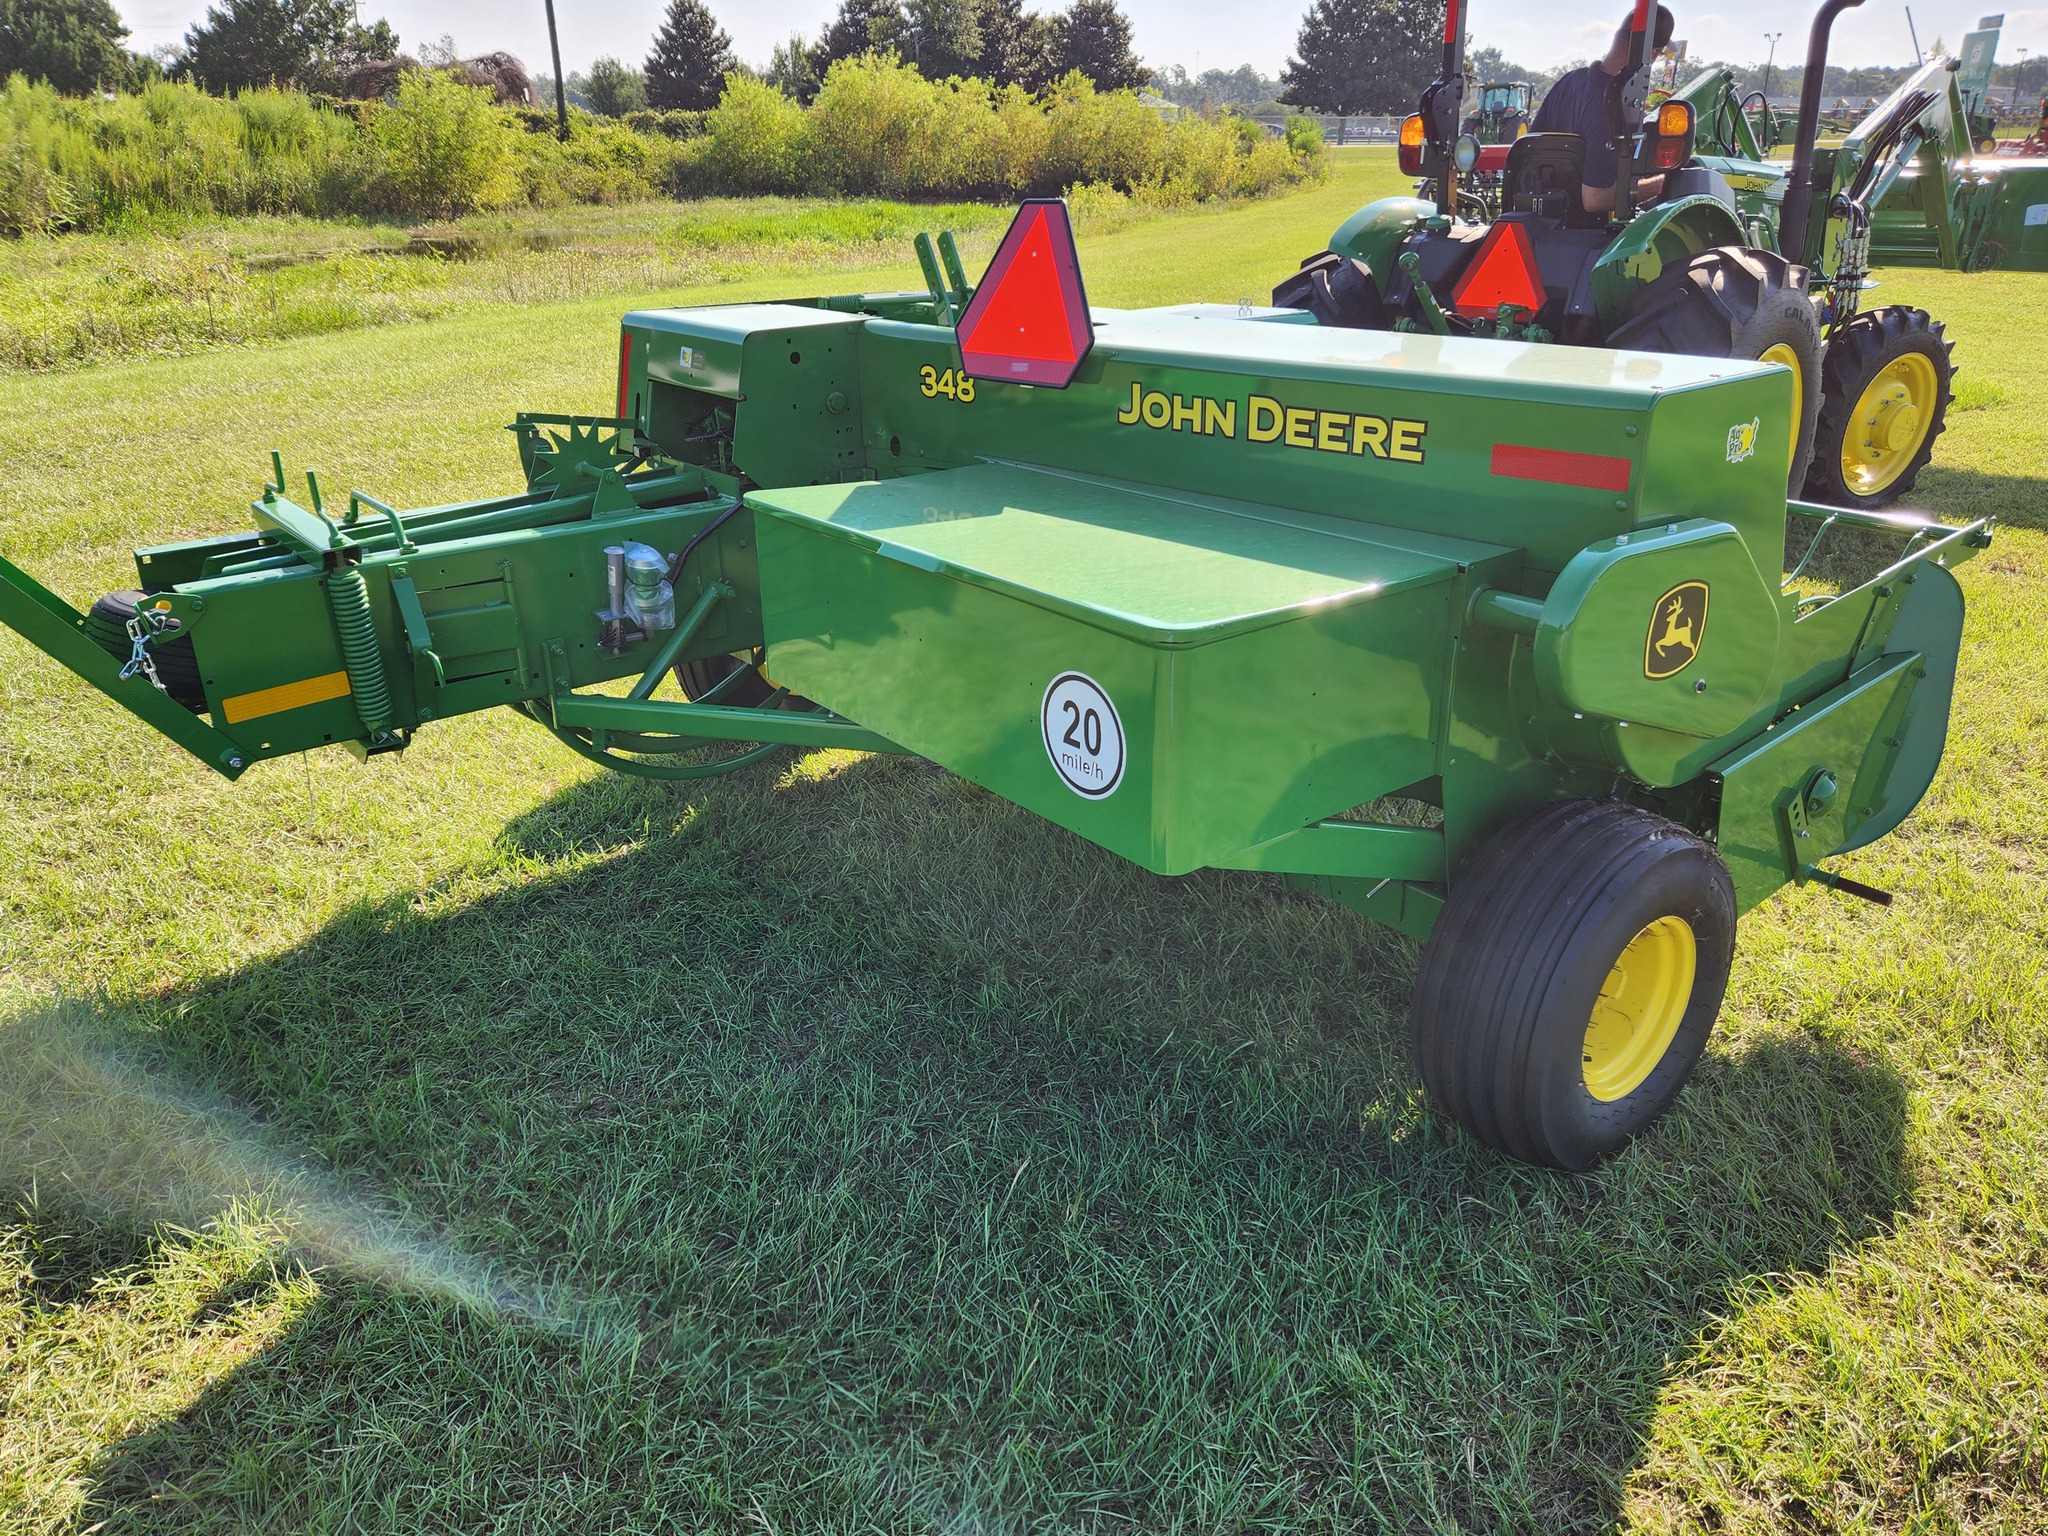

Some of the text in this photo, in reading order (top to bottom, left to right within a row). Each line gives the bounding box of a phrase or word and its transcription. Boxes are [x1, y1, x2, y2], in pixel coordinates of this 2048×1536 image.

[1744, 179, 1763, 192] JOHN
[919, 364, 977, 403] 348
[1117, 381, 1429, 465] JOHN DEERE
[1062, 700, 1102, 756] 20
[1062, 752, 1104, 781] mile/h
